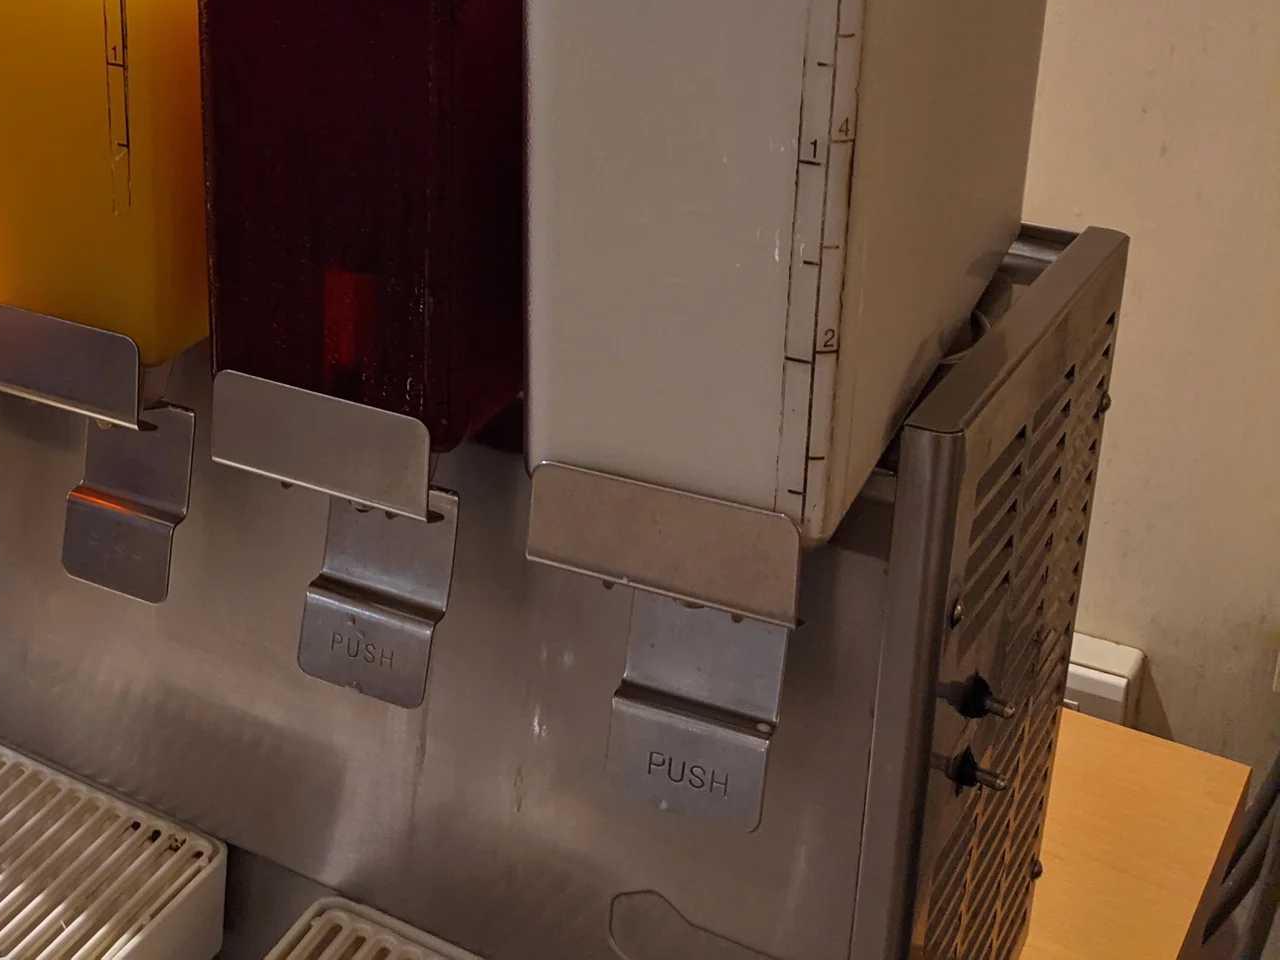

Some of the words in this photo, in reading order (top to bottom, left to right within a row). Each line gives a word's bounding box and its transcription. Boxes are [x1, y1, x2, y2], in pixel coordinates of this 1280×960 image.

[838, 117, 850, 137] 4
[809, 138, 818, 160] 1
[823, 328, 835, 349] 2
[331, 632, 394, 670] PUSH
[647, 751, 729, 798] PUSH
